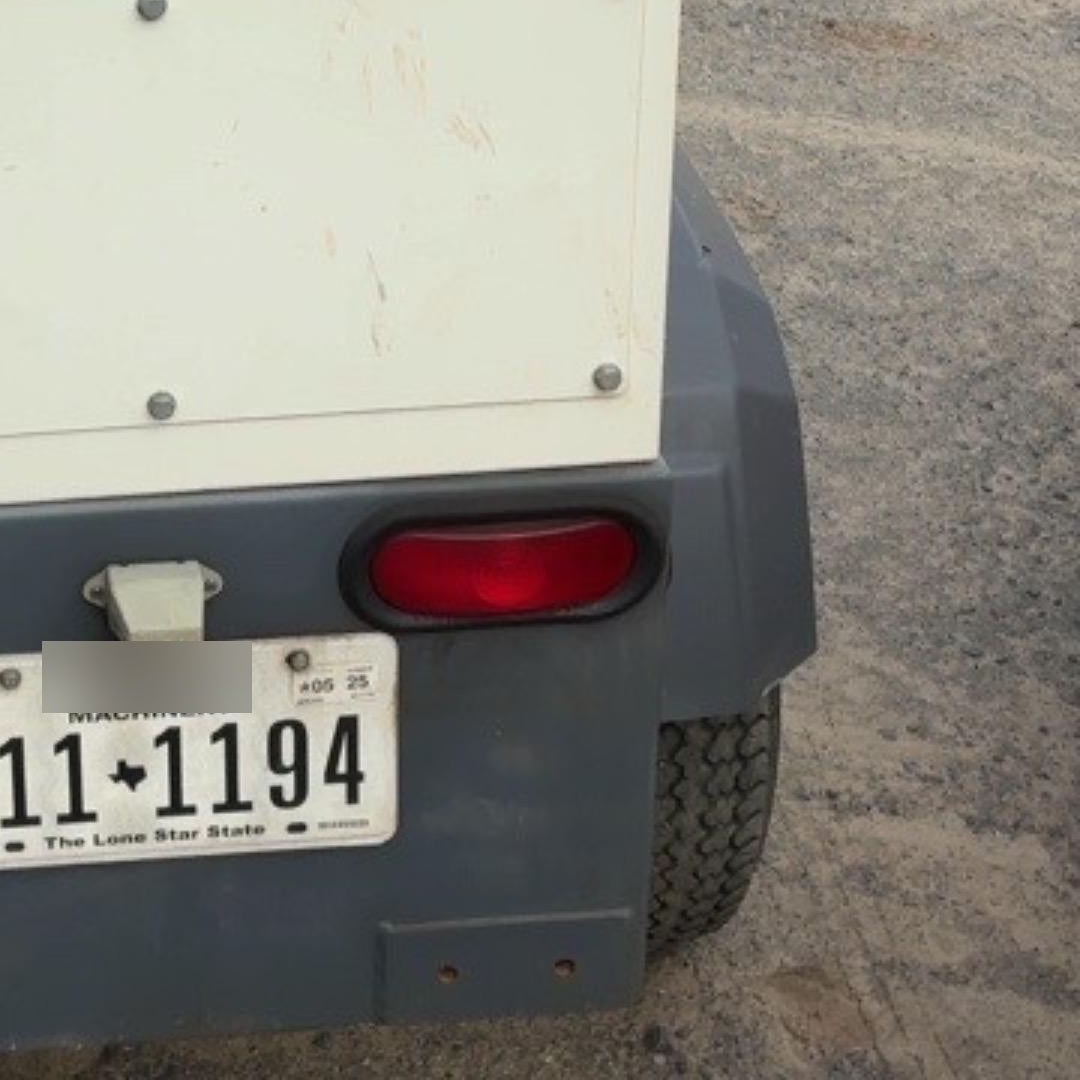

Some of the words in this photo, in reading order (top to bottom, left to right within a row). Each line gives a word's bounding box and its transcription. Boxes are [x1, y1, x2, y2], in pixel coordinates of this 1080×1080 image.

[154, 714, 366, 818] 1194
[44, 834, 86, 851] The
[93, 830, 147, 848] Lone
[154, 825, 200, 843] Star
[207, 822, 267, 839] State
